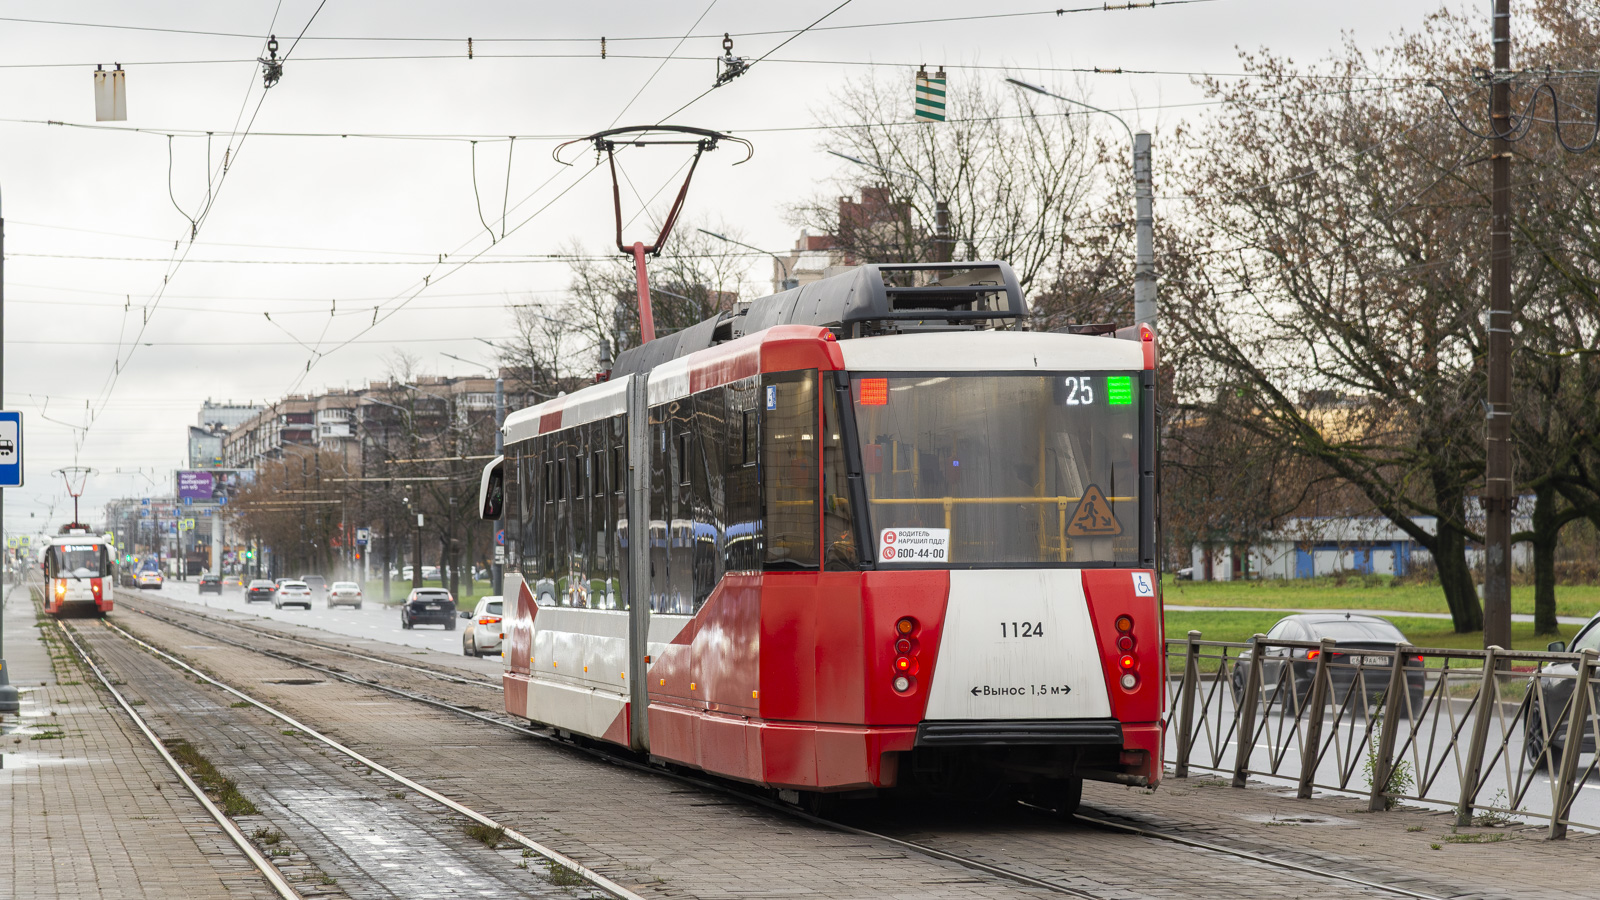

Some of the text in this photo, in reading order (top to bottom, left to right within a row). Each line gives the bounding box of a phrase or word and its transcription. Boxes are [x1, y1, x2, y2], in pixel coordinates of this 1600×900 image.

[1065, 376, 1093, 405] 25
[897, 548, 945, 559] 600-44-00
[1000, 621, 1044, 638] 1124
[983, 684, 1060, 696] Вынос 1,5 м
